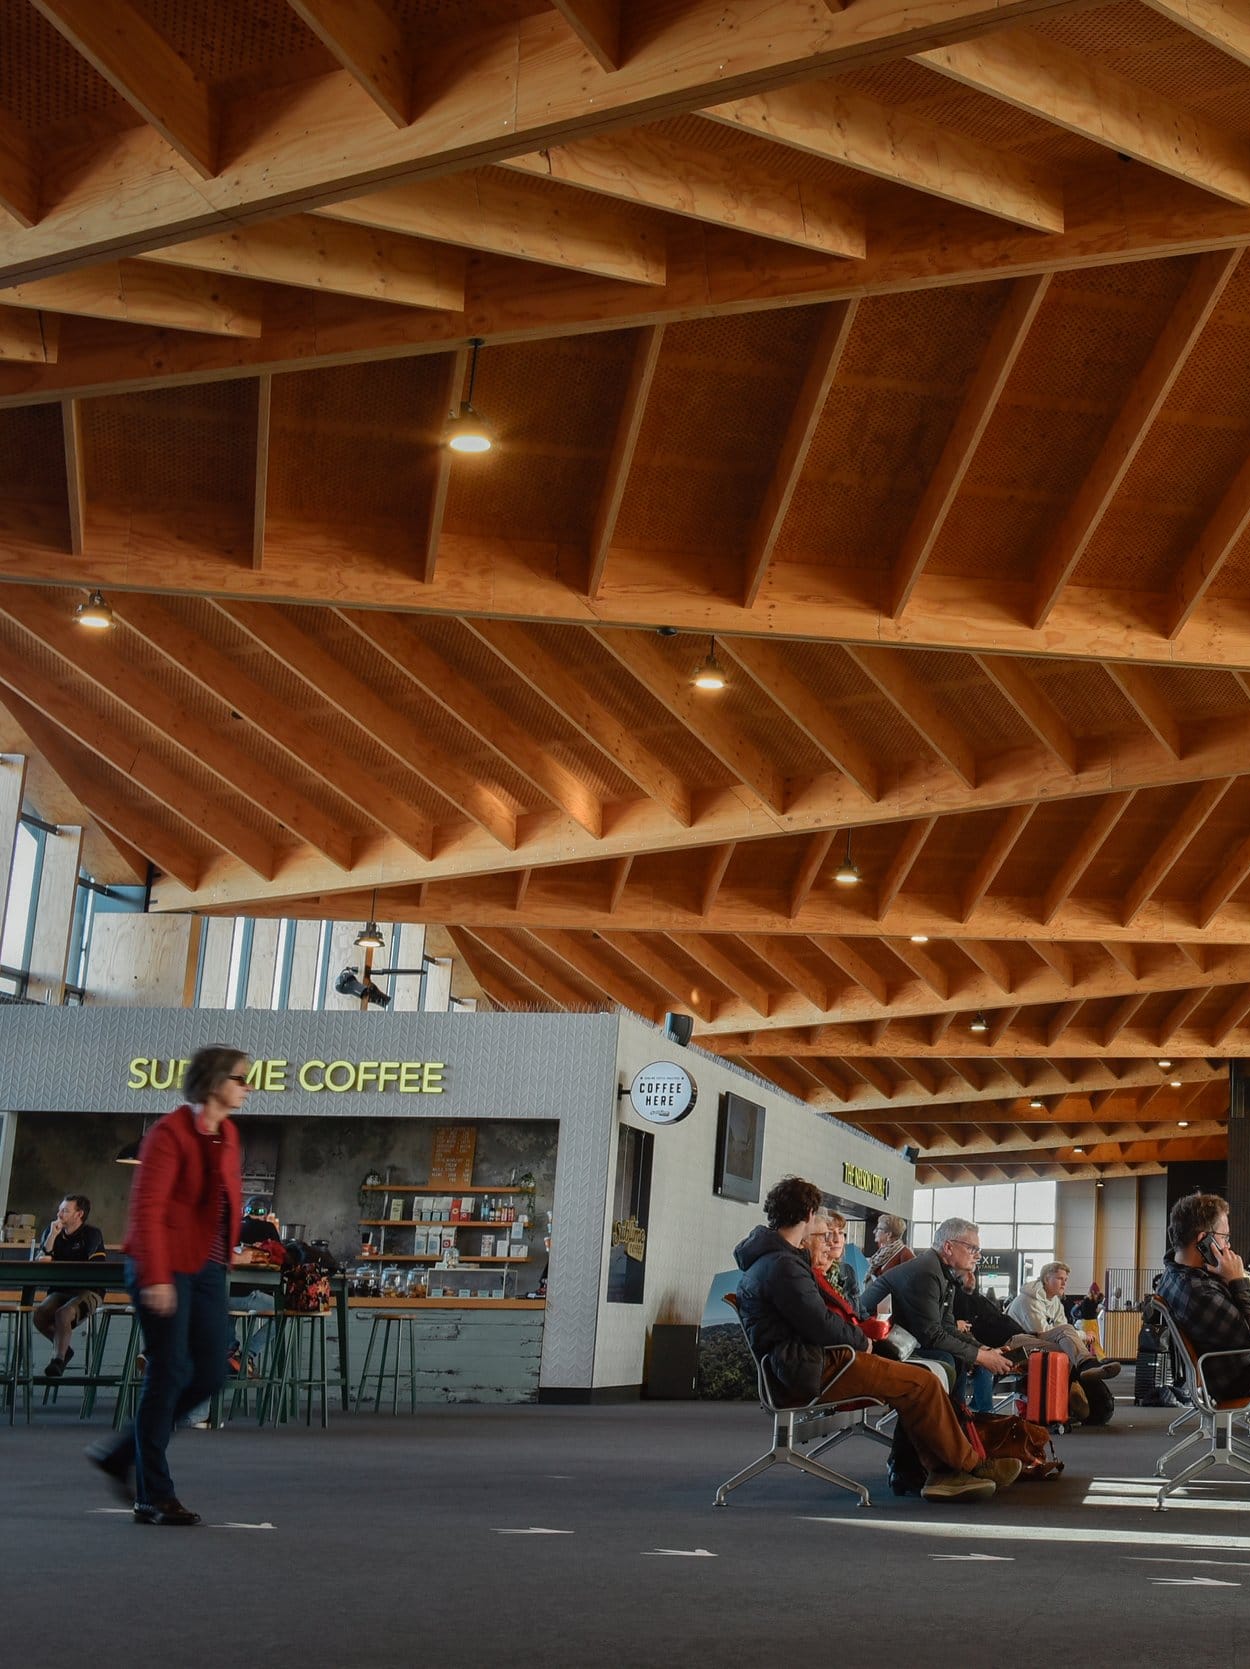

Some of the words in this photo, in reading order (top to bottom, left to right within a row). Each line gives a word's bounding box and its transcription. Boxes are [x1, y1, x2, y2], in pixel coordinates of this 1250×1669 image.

[127, 1057, 288, 1091] SUME
[299, 1060, 445, 1093] COFFEE
[639, 1083, 682, 1094] COFFEE
[645, 1095, 674, 1106] HERE
